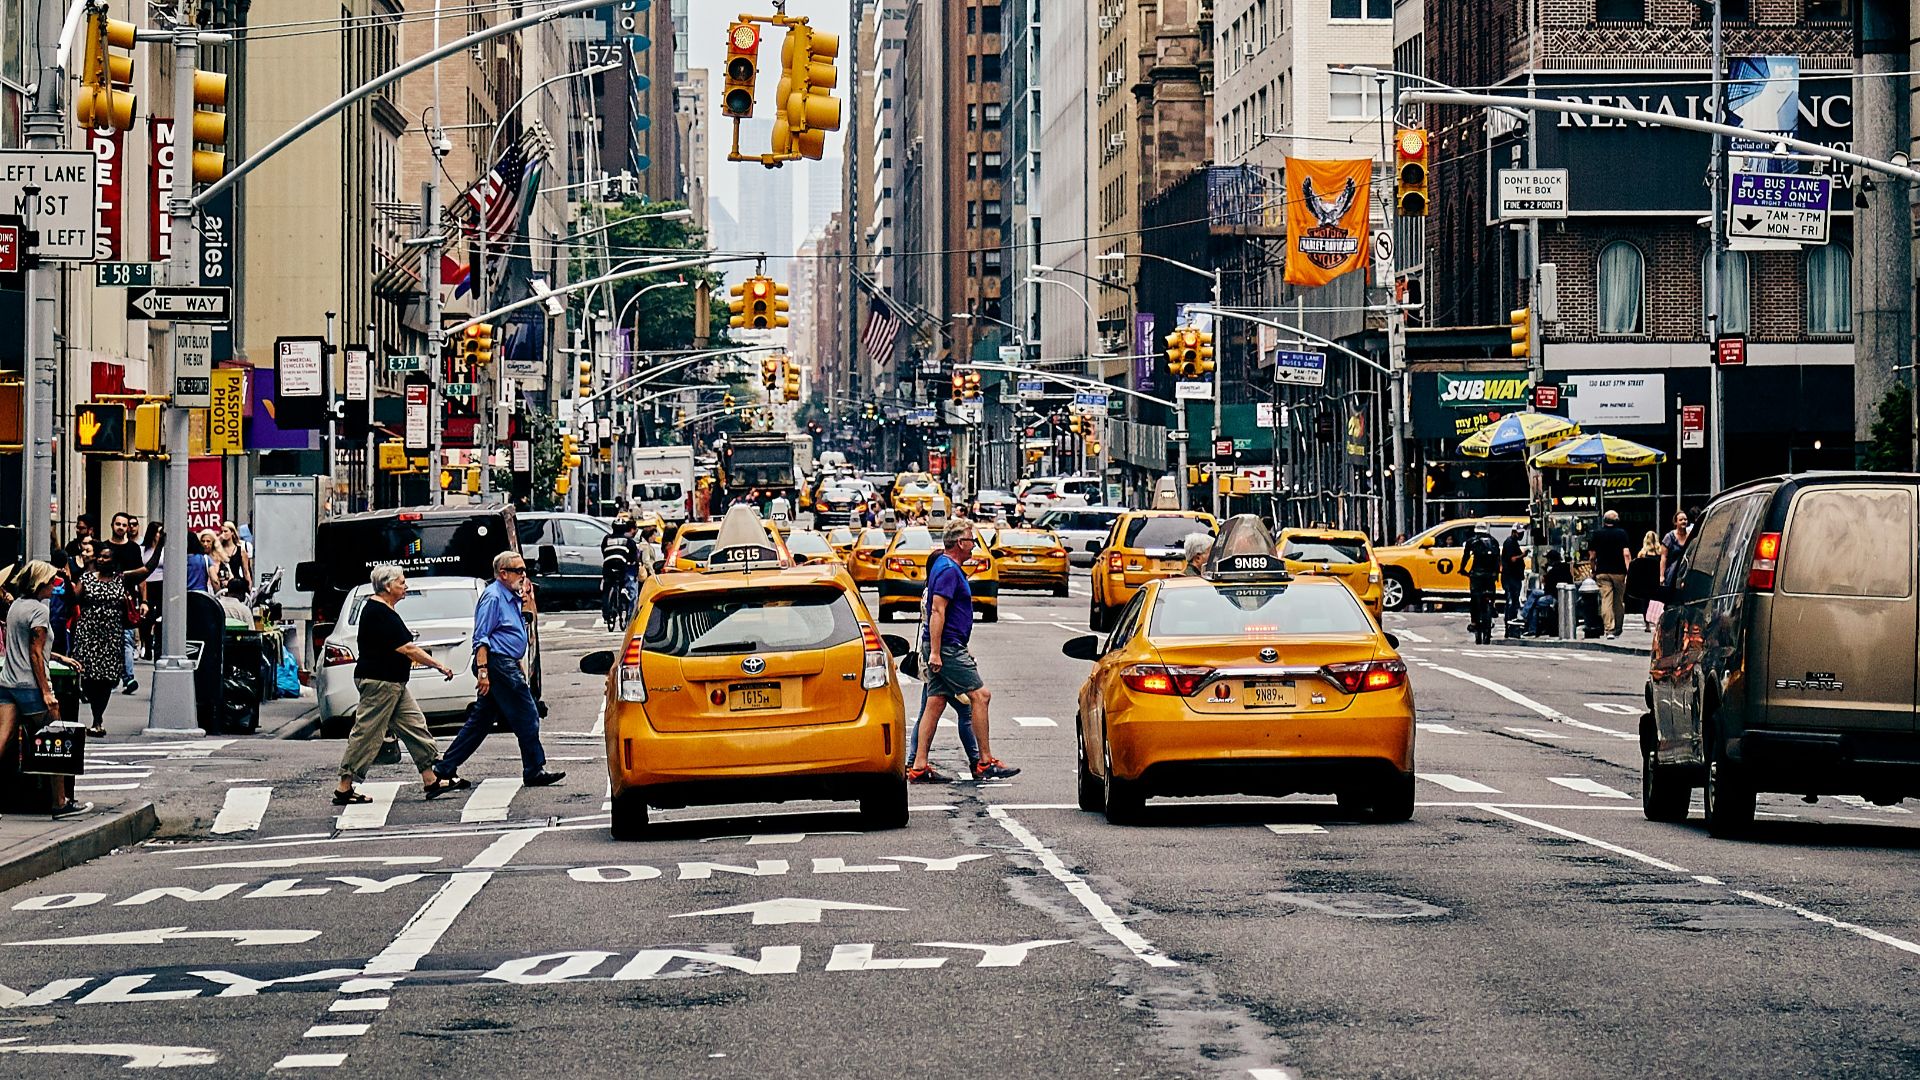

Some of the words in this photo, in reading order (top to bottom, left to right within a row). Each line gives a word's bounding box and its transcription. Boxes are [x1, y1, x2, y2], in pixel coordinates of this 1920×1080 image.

[588, 45, 623, 64] 575
[45, 166, 86, 182] LANE
[1504, 176, 1530, 185] DON'T
[1532, 176, 1562, 185] BLOCK
[1515, 186, 1532, 195] THE
[1534, 186, 1552, 195] BOX
[1764, 178, 1786, 188] BUS
[1790, 180, 1820, 191] LANE
[156, 123, 175, 264] MODELL
[1737, 187, 1782, 200] BUSES
[1788, 190, 1823, 203] ONLY
[1505, 201, 1521, 210] FINE
[1523, 201, 1535, 209] +2
[1536, 201, 1561, 210] POINTS
[1767, 223, 1790, 234] MON
[1801, 225, 1819, 236] FRI
[47, 229, 86, 246] LEFT
[99, 264, 107, 284] E
[113, 264, 130, 284] 58
[136, 265, 148, 275] ST
[143, 297, 172, 310] ONE
[186, 297, 217, 311] WAY
[192, 336, 209, 349] BLOCK
[282, 343, 290, 355] 3
[183, 353, 193, 366] THE
[193, 353, 203, 366] BOX
[389, 358, 394, 369] E
[397, 358, 408, 370] 57
[1441, 379, 1529, 401] SUBWAY
[1627, 379, 1645, 387] STREET
[213, 388, 226, 435] PHOTO
[227, 377, 240, 447] PASSPORT
[1455, 417, 1471, 428] my
[265, 479, 303, 488] Phone
[187, 485, 219, 500] 00%
[365, 558, 411, 568] NOUVEAU
[413, 555, 461, 566] ELEVATOR
[726, 548, 760, 562] 1G15
[1234, 557, 1268, 569] 9N89
[1440, 560, 1450, 573] T
[742, 690, 770, 705] 1G15H
[1255, 688, 1284, 702] 9N89H
[567, 853, 993, 883] ONLY
[11, 872, 440, 911] ONLY
[479, 939, 1073, 984] ONLY
